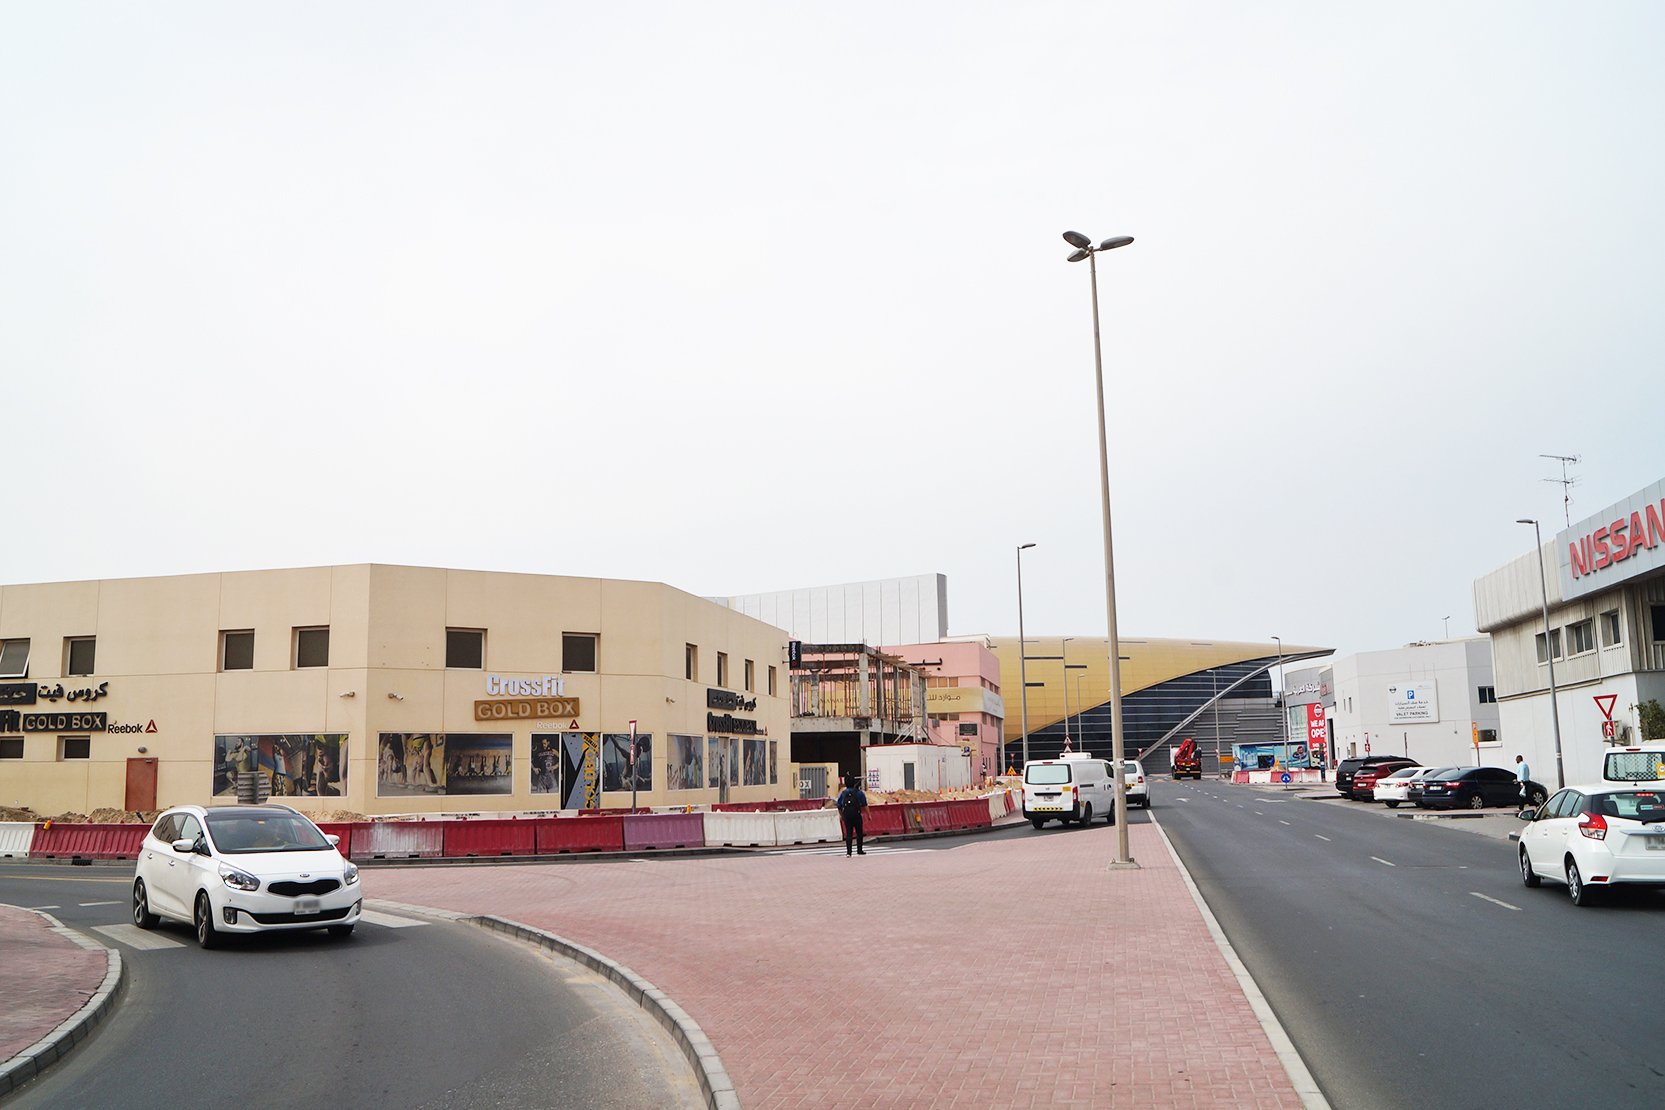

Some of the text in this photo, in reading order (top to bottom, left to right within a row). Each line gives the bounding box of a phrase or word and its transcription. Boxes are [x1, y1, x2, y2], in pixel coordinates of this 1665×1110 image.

[1569, 498, 1665, 579] NISSAN
[38, 683, 64, 702] فيت
[66, 682, 108, 702] كروس
[486, 672, 566, 697] CrossFit
[478, 701, 576, 718] GOLD BOX
[26, 715, 67, 730] GOLD
[71, 714, 103, 729] BOX
[107, 723, 143, 734] Reebok
[536, 721, 567, 730] Reebok
[1311, 728, 1325, 738] OPE
